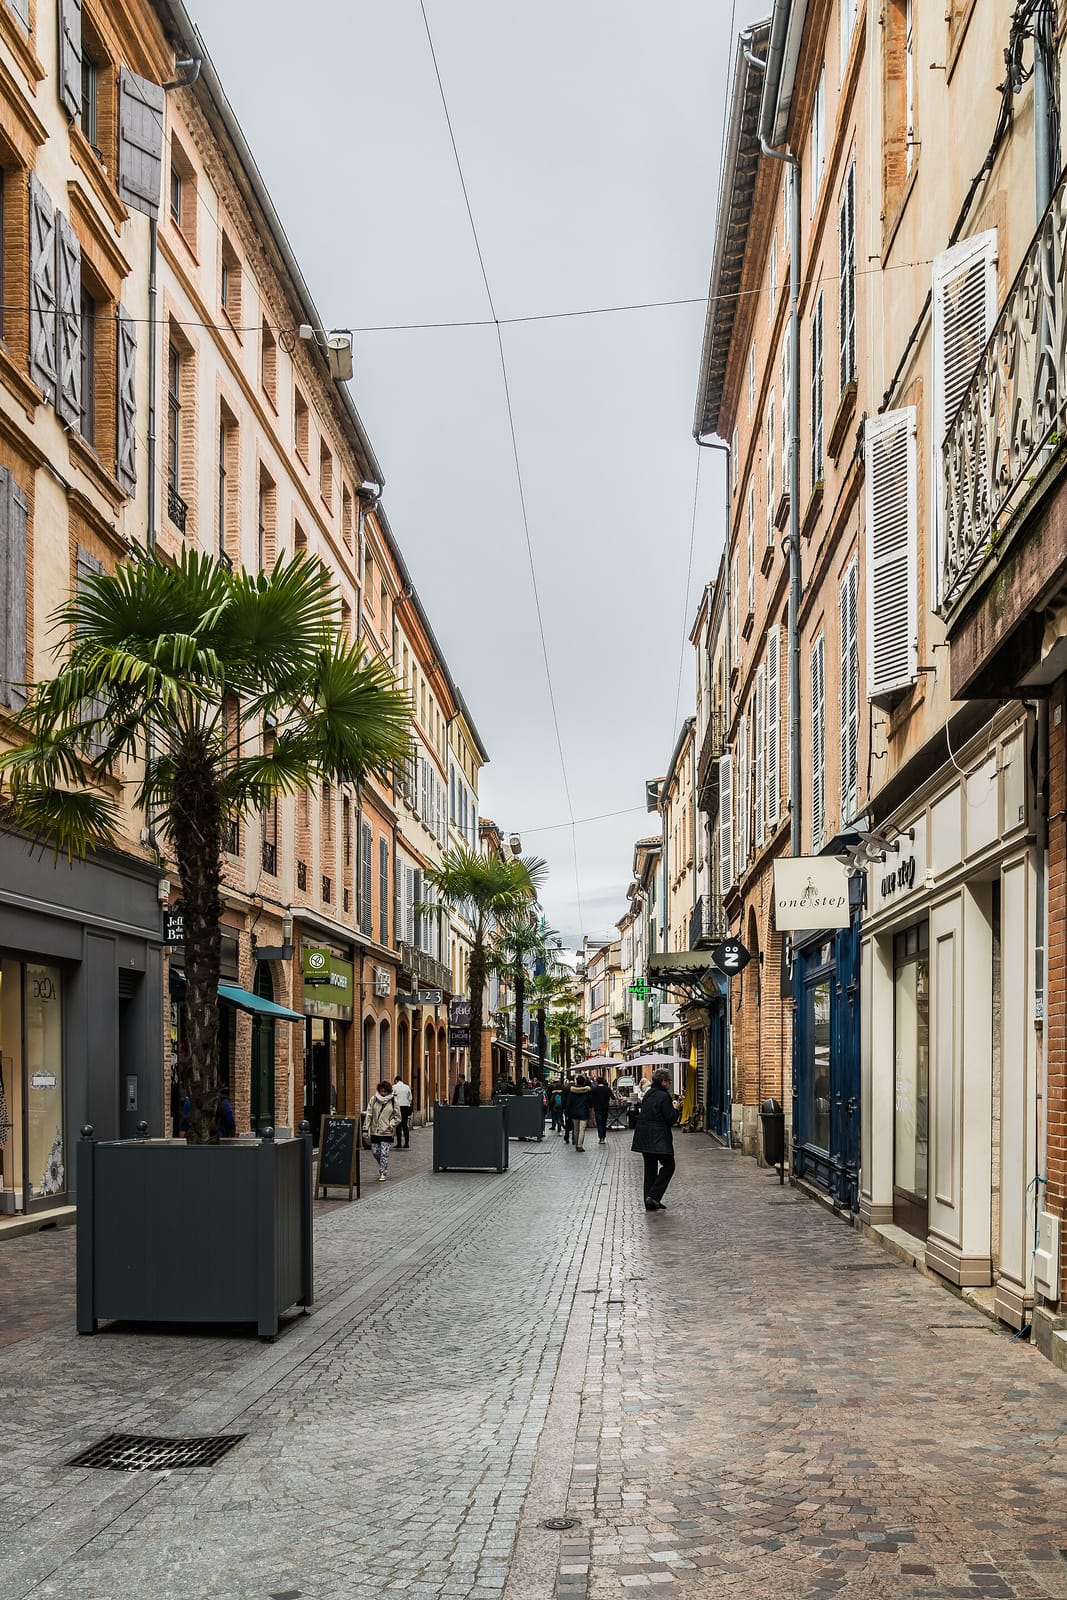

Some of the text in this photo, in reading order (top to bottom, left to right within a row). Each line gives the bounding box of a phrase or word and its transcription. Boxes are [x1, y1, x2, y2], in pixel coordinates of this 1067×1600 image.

[881, 856, 916, 897] one step
[779, 896, 846, 908] one step
[167, 916, 184, 927] Jeff
[425, 991, 431, 1000] 2
[434, 991, 441, 1004] 3
